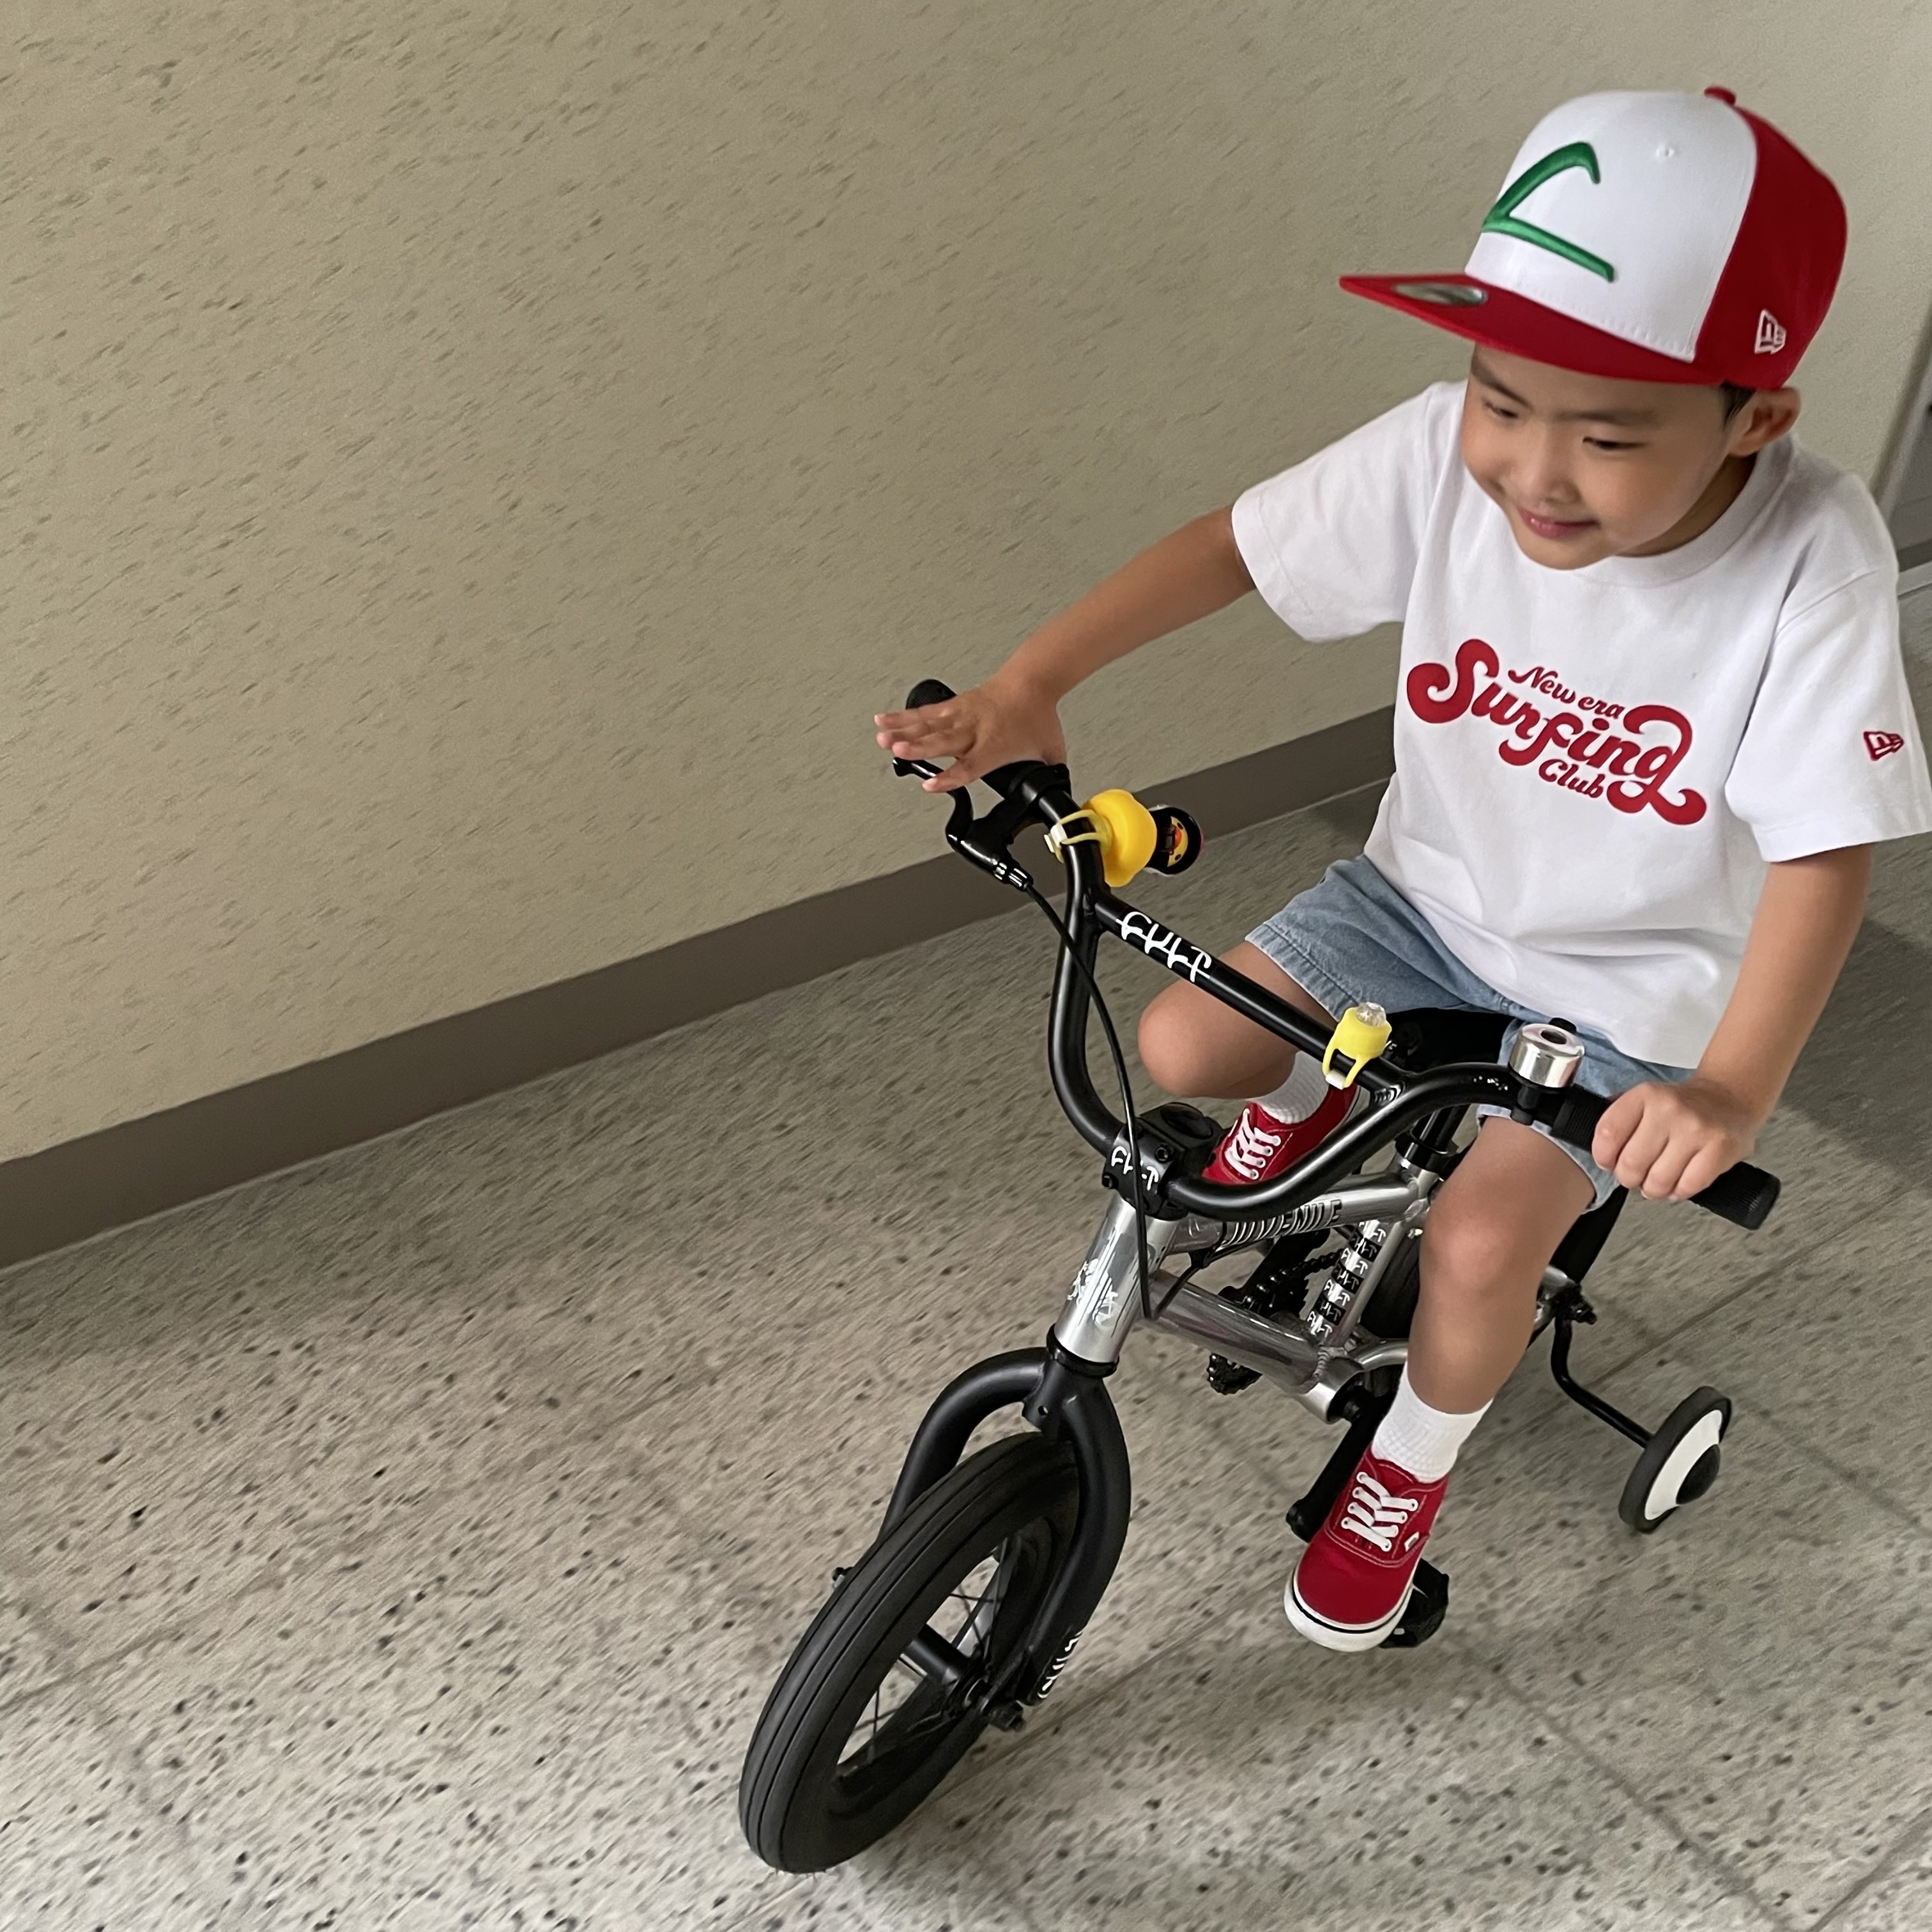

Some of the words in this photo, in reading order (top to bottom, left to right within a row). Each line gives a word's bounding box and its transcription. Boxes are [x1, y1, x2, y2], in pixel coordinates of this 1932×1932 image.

[1508, 666, 1575, 704] New
[1577, 695, 1624, 719] era
[1407, 639, 1707, 825] Surfing
[1538, 759, 1604, 798] Club
